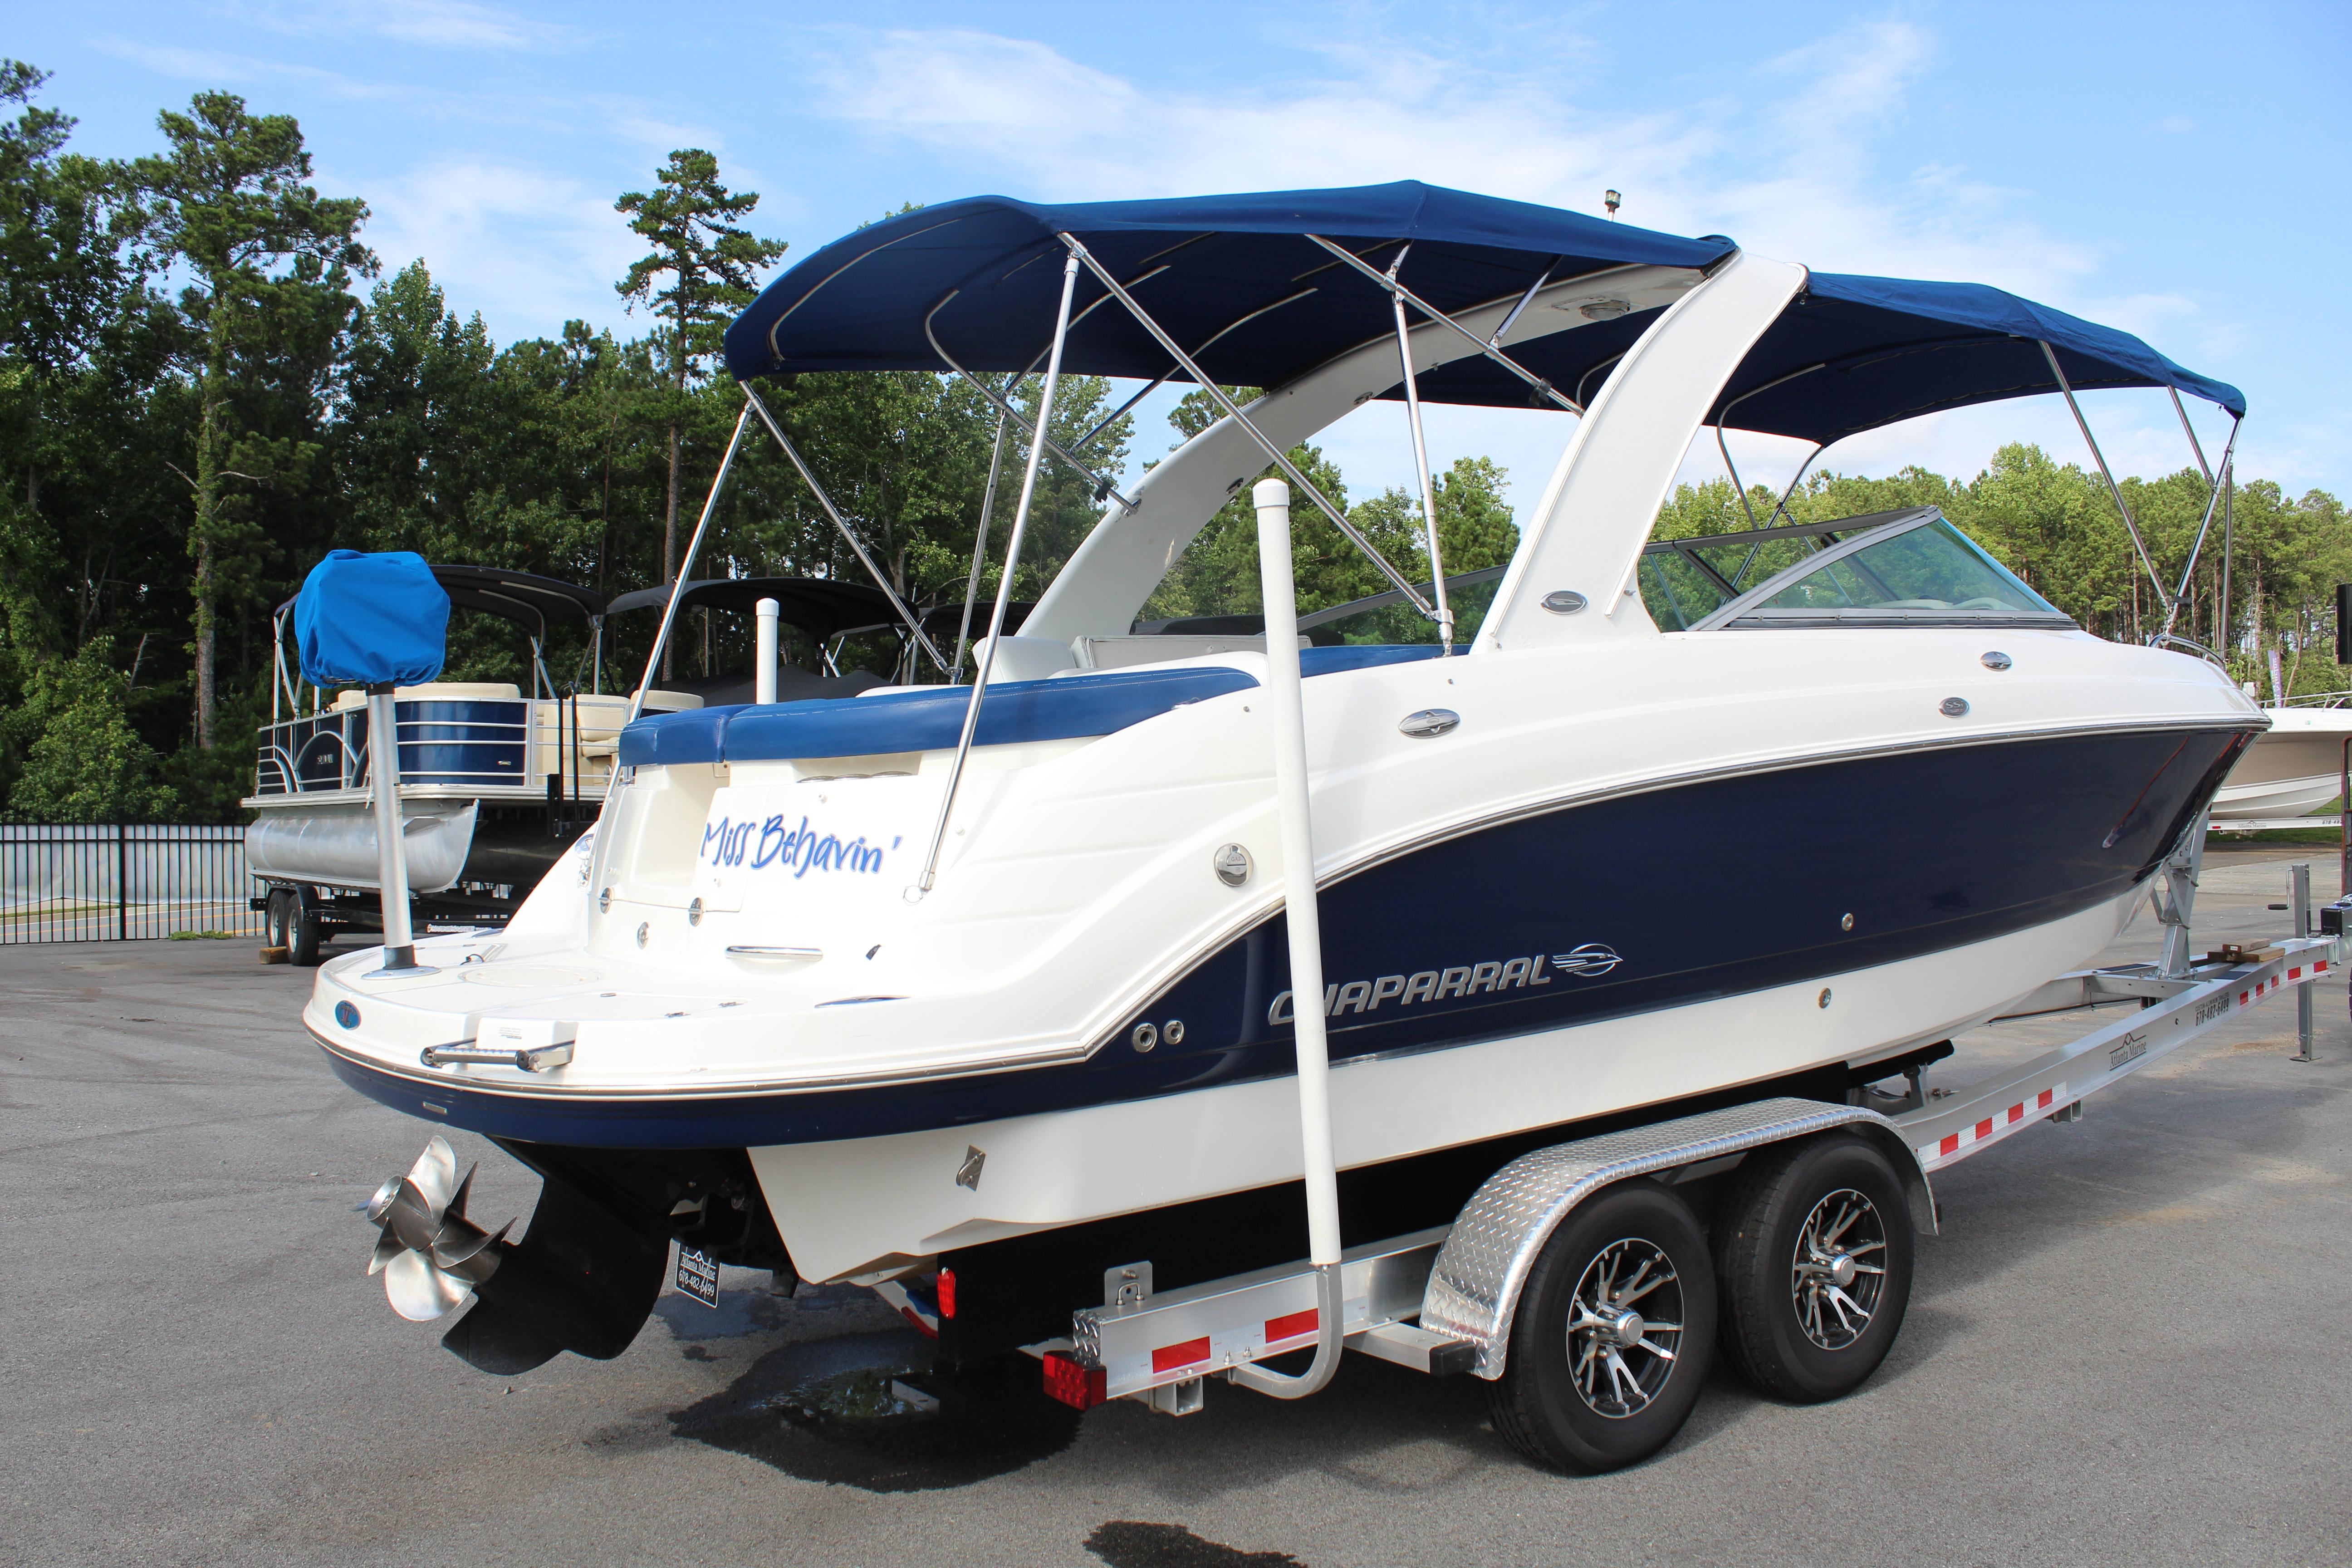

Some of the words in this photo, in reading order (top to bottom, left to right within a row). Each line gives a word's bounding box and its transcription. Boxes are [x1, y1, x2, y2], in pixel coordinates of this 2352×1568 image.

[701, 816, 756, 867] Miss
[2110, 1050, 2128, 1068] Atlanta
[2129, 1041, 2146, 1058] Marine
[681, 1255, 698, 1270] Atlanta
[698, 1262, 715, 1279] Marine
